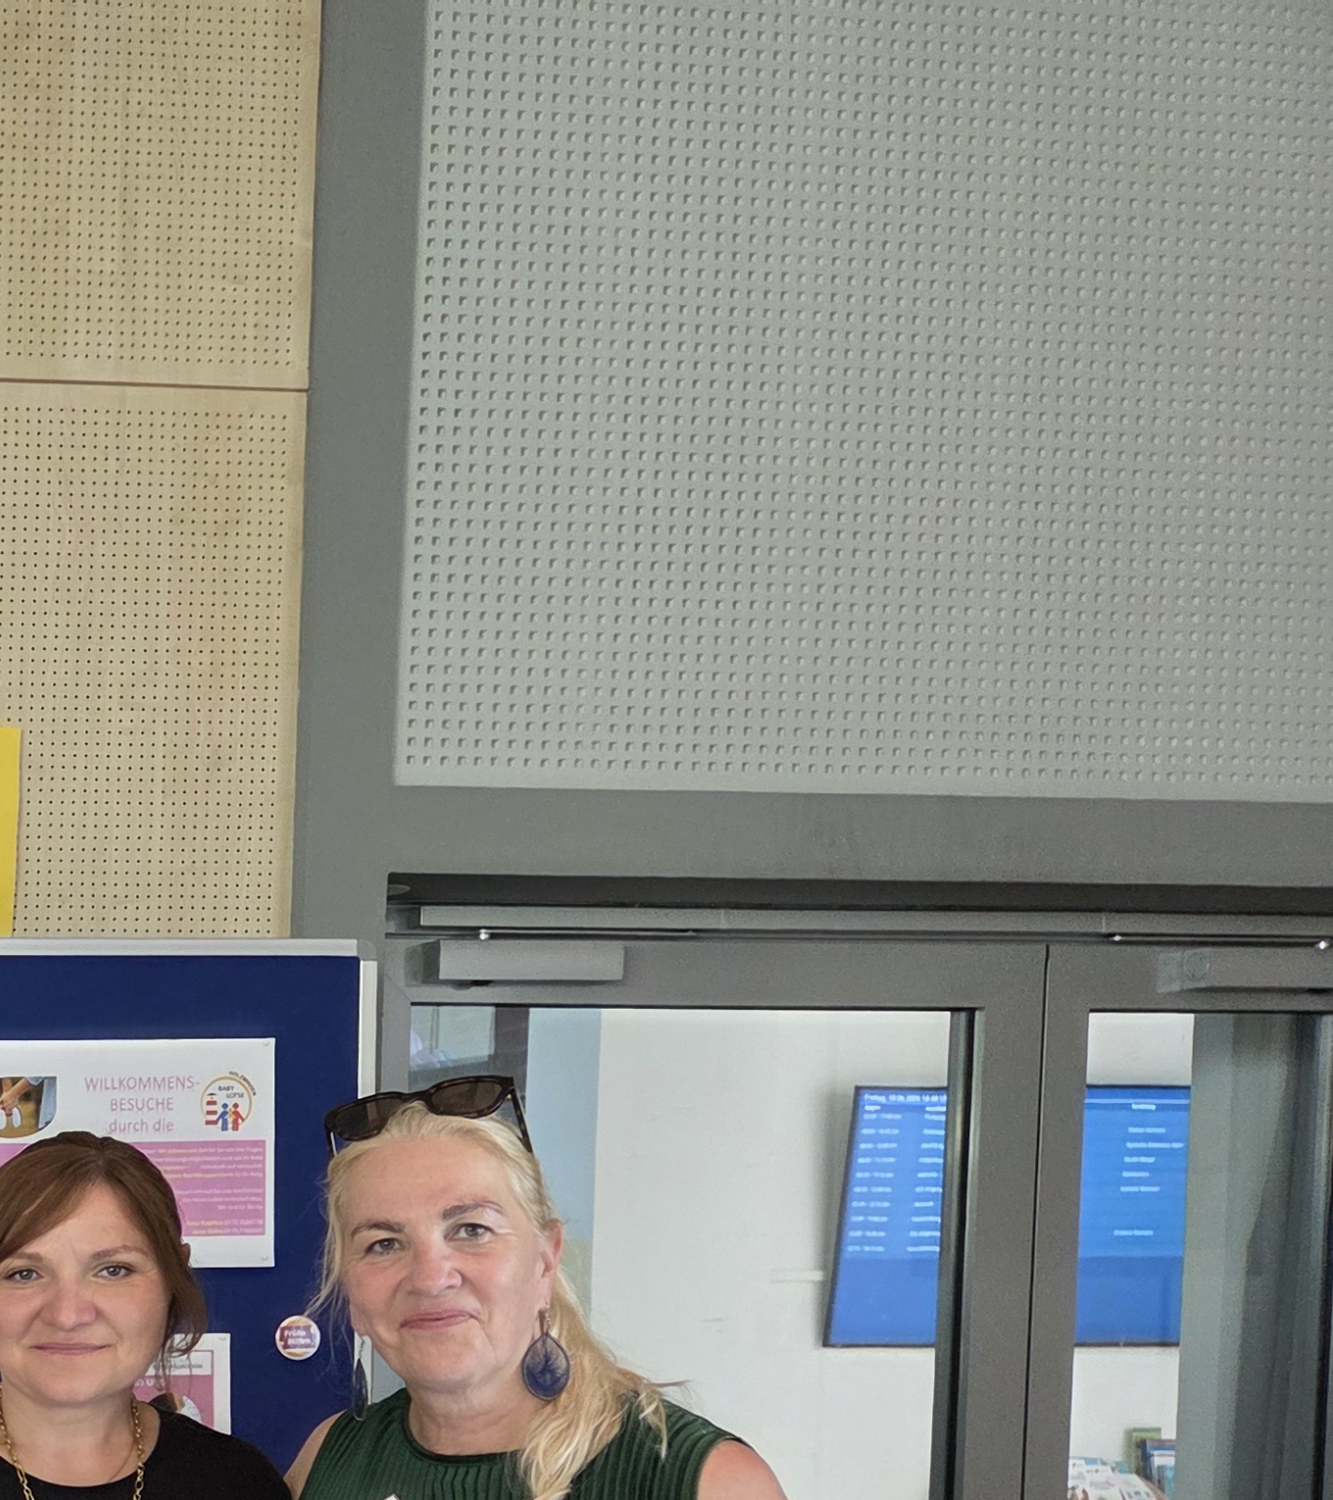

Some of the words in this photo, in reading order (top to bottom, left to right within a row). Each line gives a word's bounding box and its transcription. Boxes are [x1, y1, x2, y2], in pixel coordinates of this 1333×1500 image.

[84, 1076, 200, 1092] WILLKOMMENS-
[110, 1098, 174, 1112] BESUCHE
[108, 1118, 148, 1133] durch
[153, 1118, 174, 1132] die
